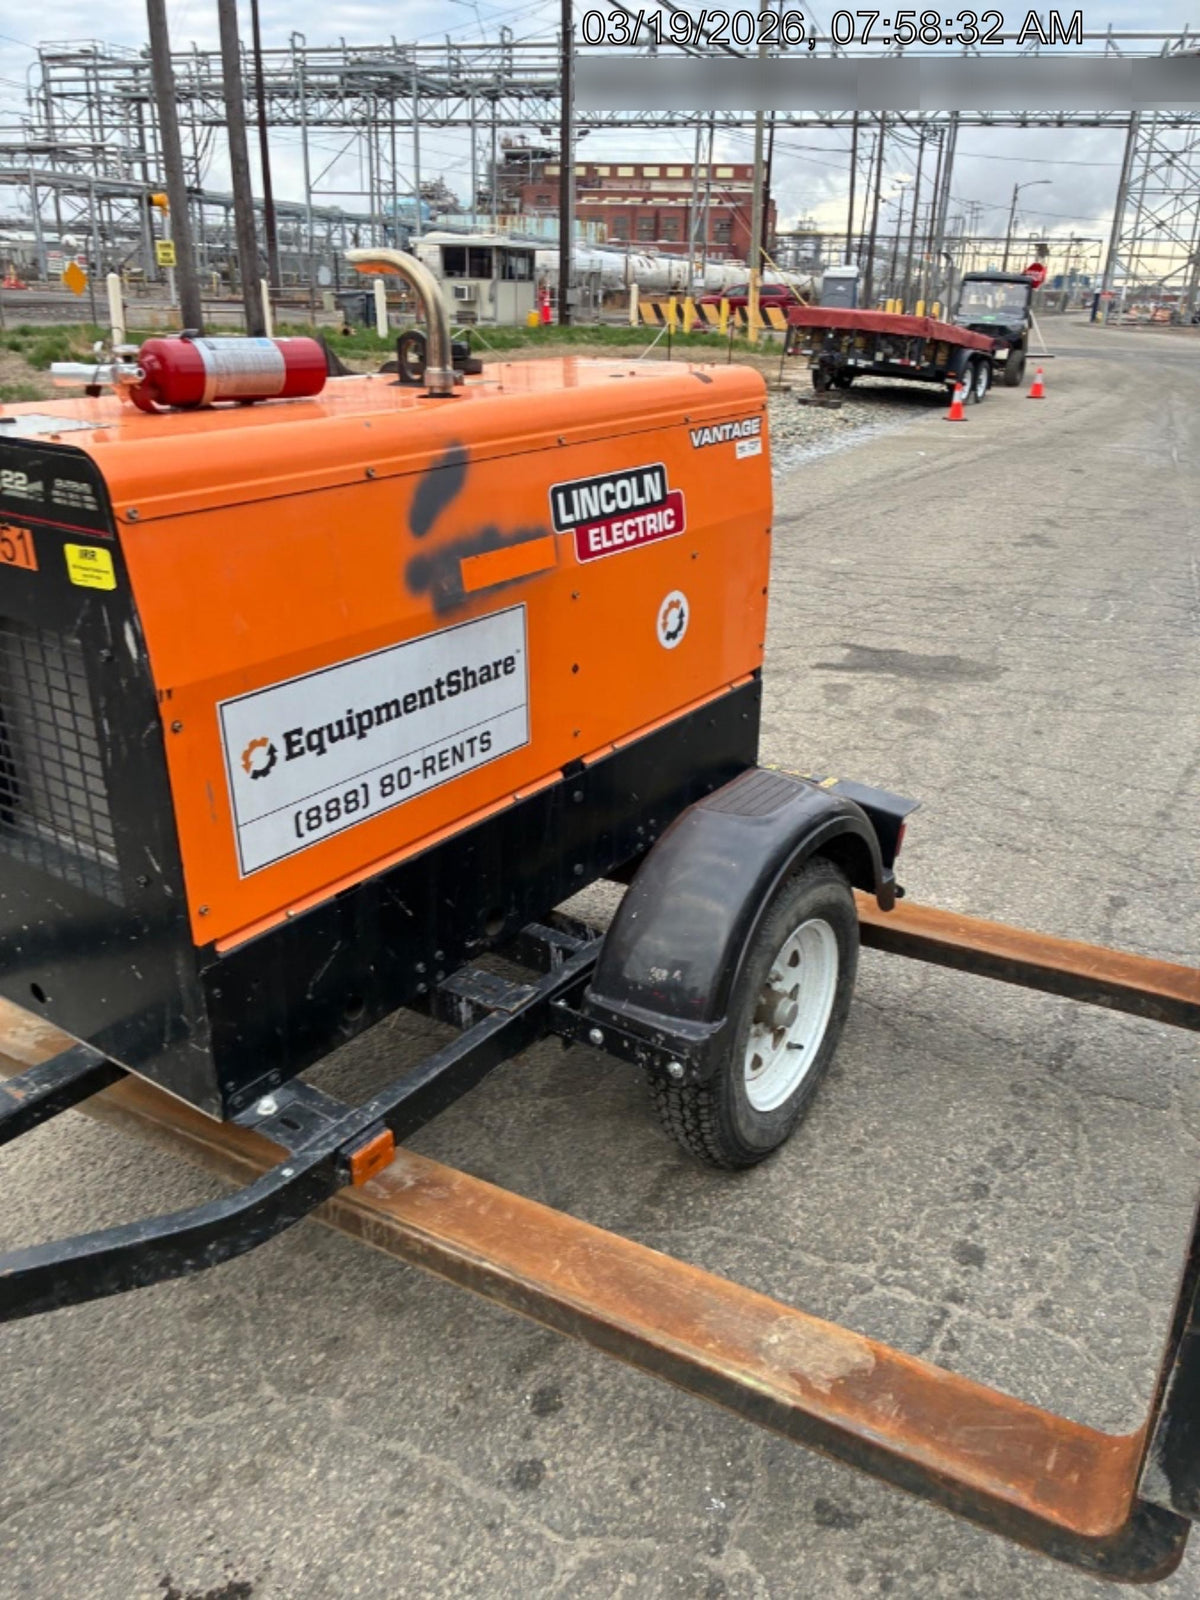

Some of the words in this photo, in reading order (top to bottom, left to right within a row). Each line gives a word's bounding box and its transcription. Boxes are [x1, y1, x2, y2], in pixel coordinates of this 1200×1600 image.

[690, 417, 761, 449] VANTAGE
[557, 471, 663, 525] LINCOLN
[588, 507, 676, 552] ELECTRIC
[283, 654, 516, 761] EquipmentShare
[294, 783, 370, 838] (888)
[380, 730, 492, 798] 80-RENTS
